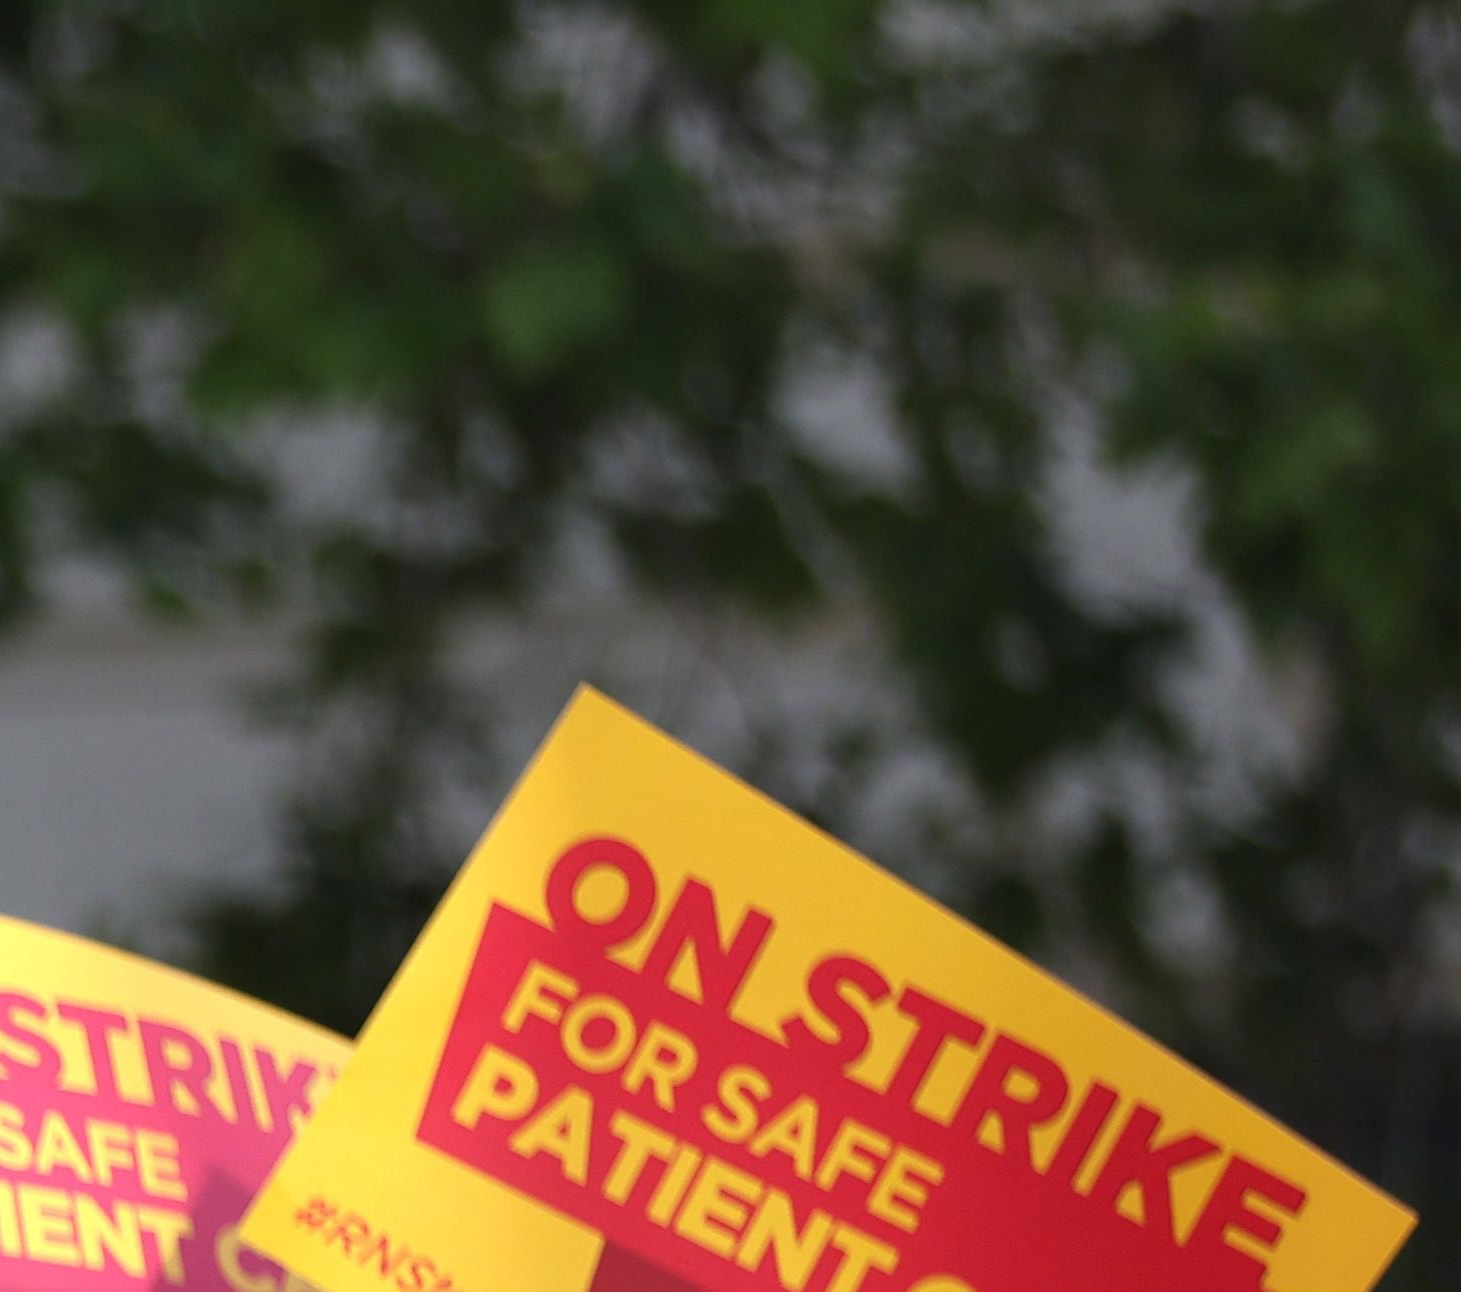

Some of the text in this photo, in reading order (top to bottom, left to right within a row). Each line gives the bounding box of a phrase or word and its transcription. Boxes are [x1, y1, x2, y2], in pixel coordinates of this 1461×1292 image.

[499, 958, 944, 1235] FOR SAFE
[545, 833, 1308, 1261] ON STRIKE
